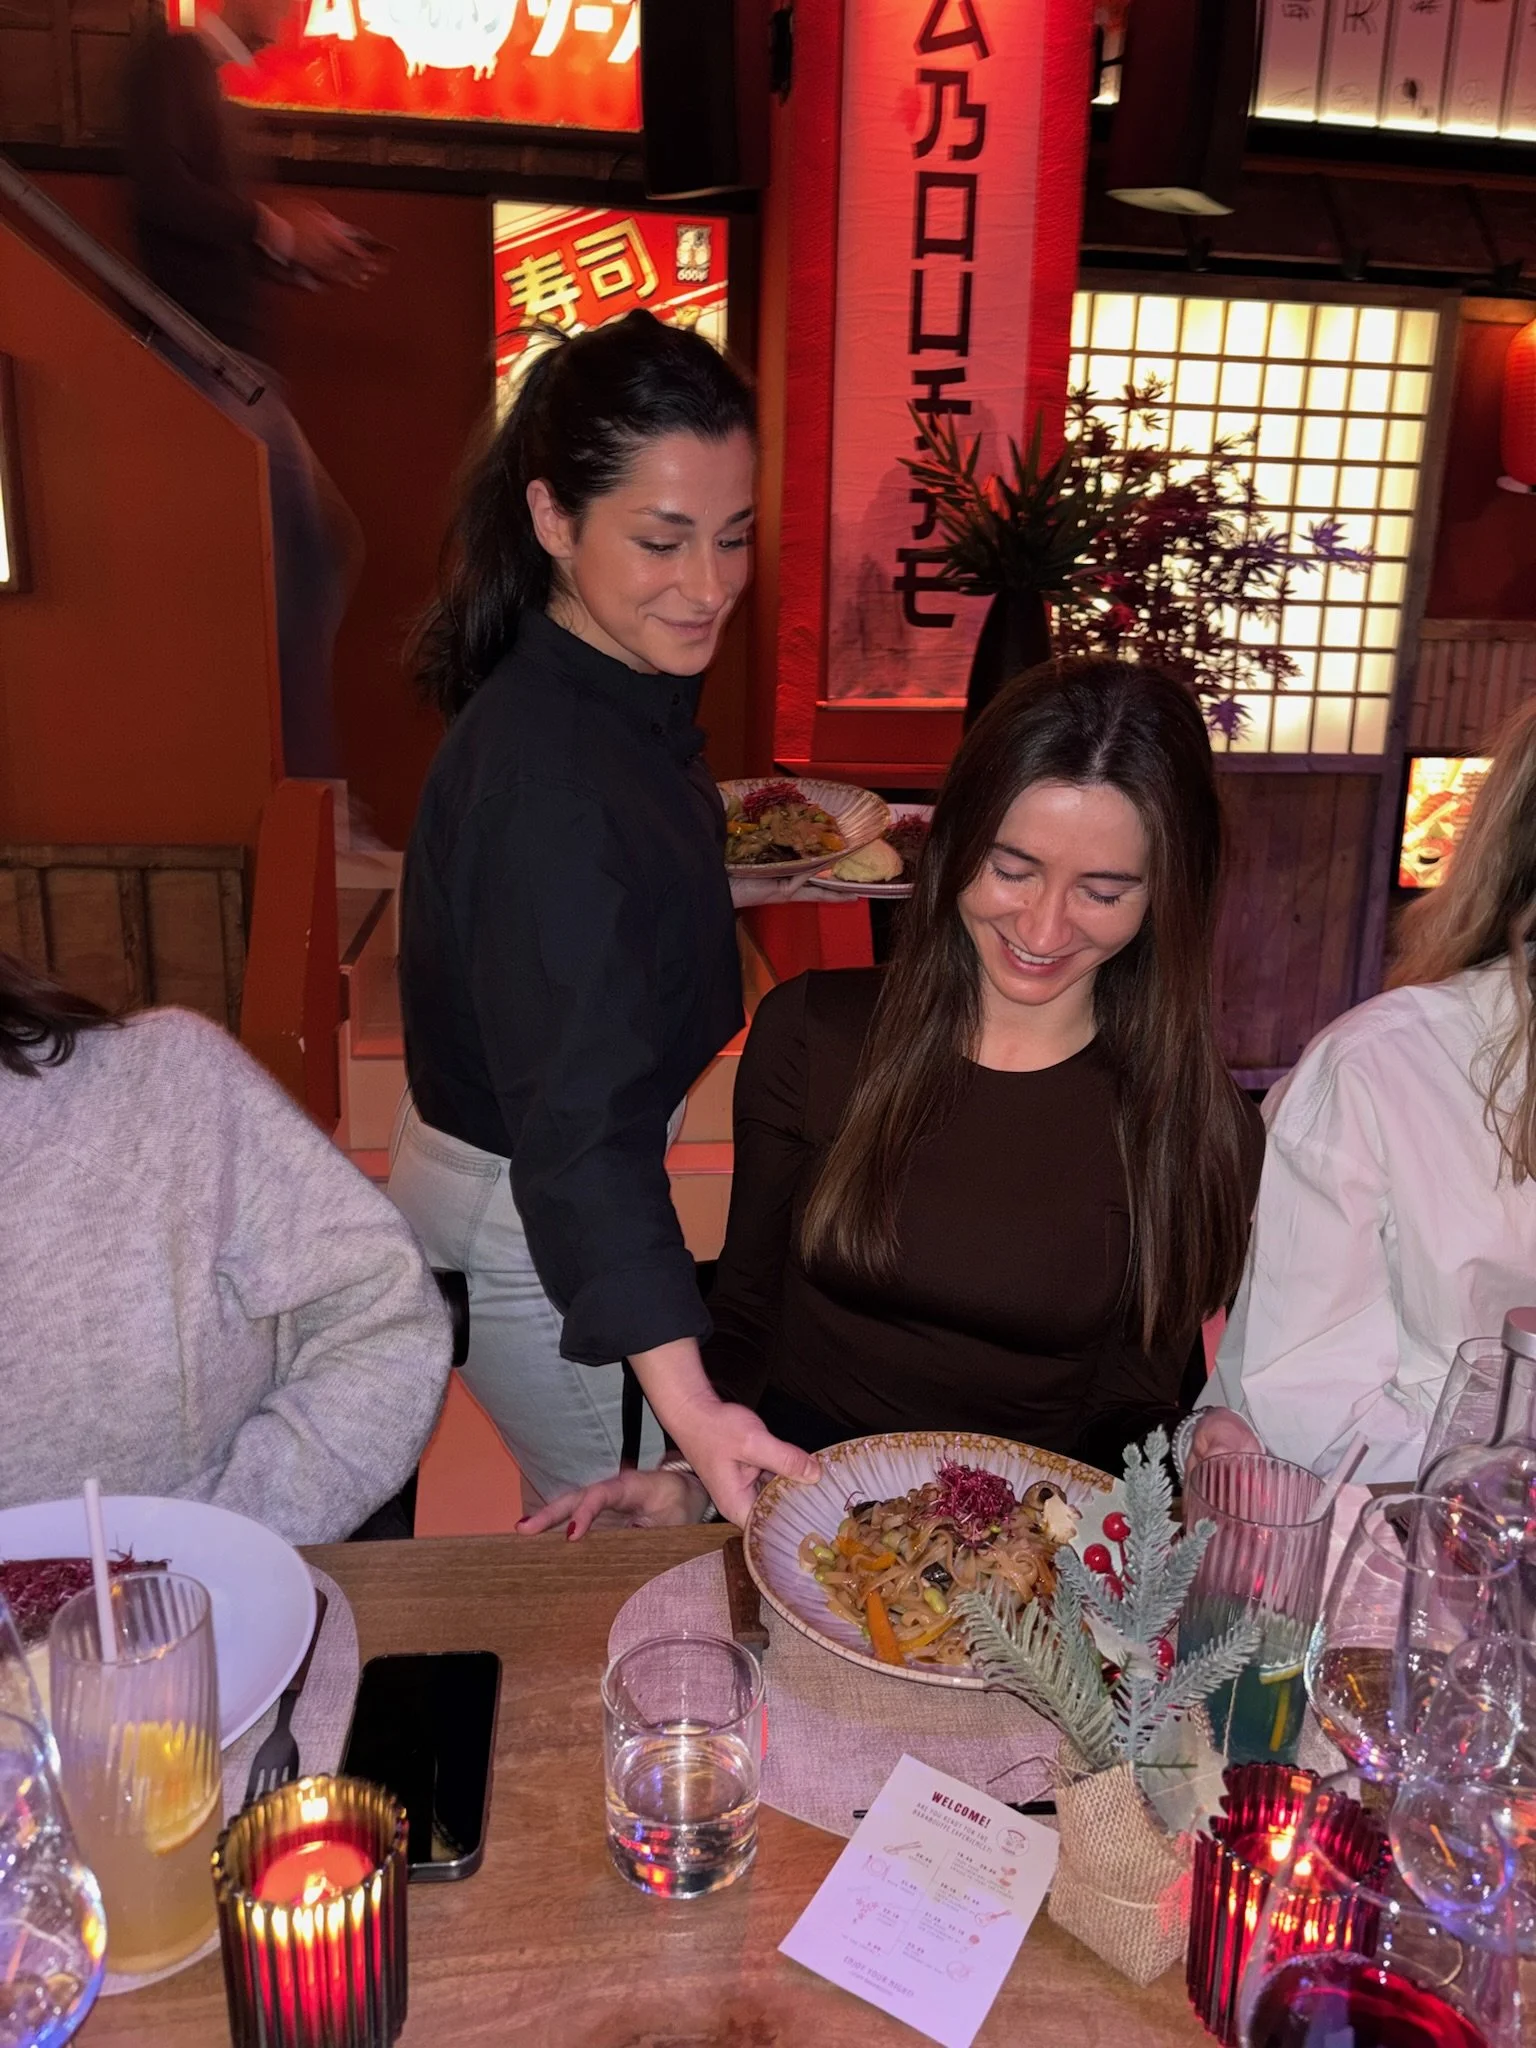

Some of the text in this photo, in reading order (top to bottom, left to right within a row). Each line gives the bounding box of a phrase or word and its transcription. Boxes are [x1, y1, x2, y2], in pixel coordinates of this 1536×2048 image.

[502, 216, 660, 331] 寿司
[930, 1808, 942, 1819] YOU
[943, 1815, 962, 1829] READY
[963, 1825, 976, 1836] FOR
[977, 1832, 989, 1843] THE
[932, 1791, 991, 1829] WELCOME!
[843, 1955, 867, 1971] ENJOY
[867, 1967, 888, 1983] YOUR
